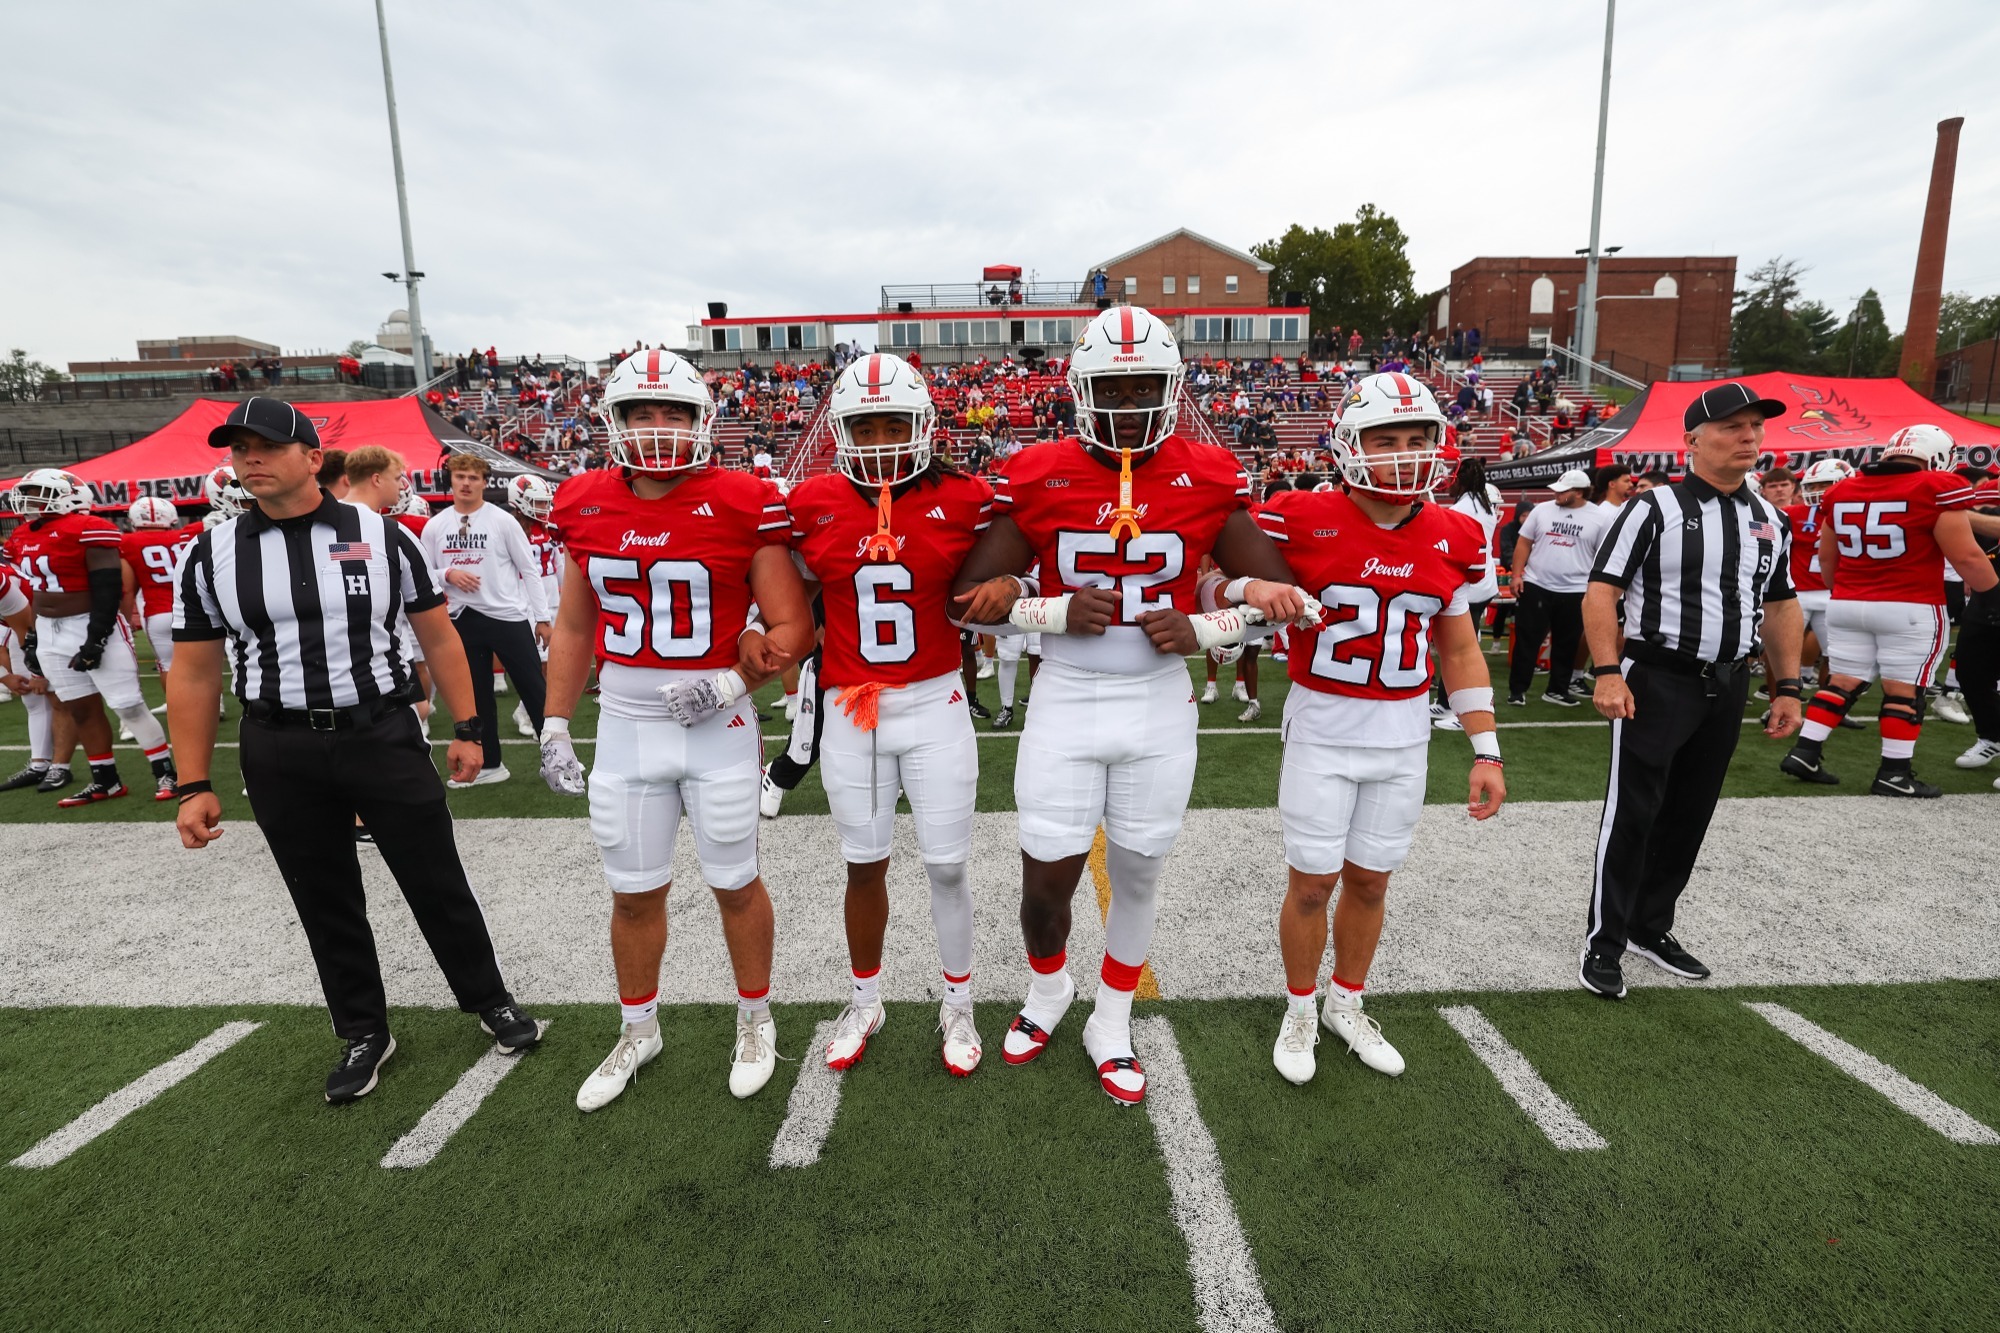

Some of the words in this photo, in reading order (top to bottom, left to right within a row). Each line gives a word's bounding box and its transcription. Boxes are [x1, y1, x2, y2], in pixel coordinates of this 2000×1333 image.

[861, 395, 890, 404] Riddell
[1393, 406, 1424, 414] Riddell
[1491, 467, 1512, 480] CRAIG
[1512, 466, 1532, 478] REAL
[1532, 462, 1563, 476] ESTATE
[1564, 459, 1591, 474] TEAM
[1552, 521, 1583, 532] WILLIAM
[1833, 501, 1907, 559] 55
[446, 540, 487, 549] JEWELL
[619, 529, 671, 552] Jewell
[450, 556, 484, 567] Football
[1360, 557, 1414, 578] Jewell
[1759, 555, 1771, 574] S
[20, 555, 65, 593] 41
[1056, 529, 1185, 625] 52
[346, 575, 369, 595] H
[587, 554, 712, 661] 50
[853, 562, 918, 665] 6
[1308, 582, 1445, 689] 20
